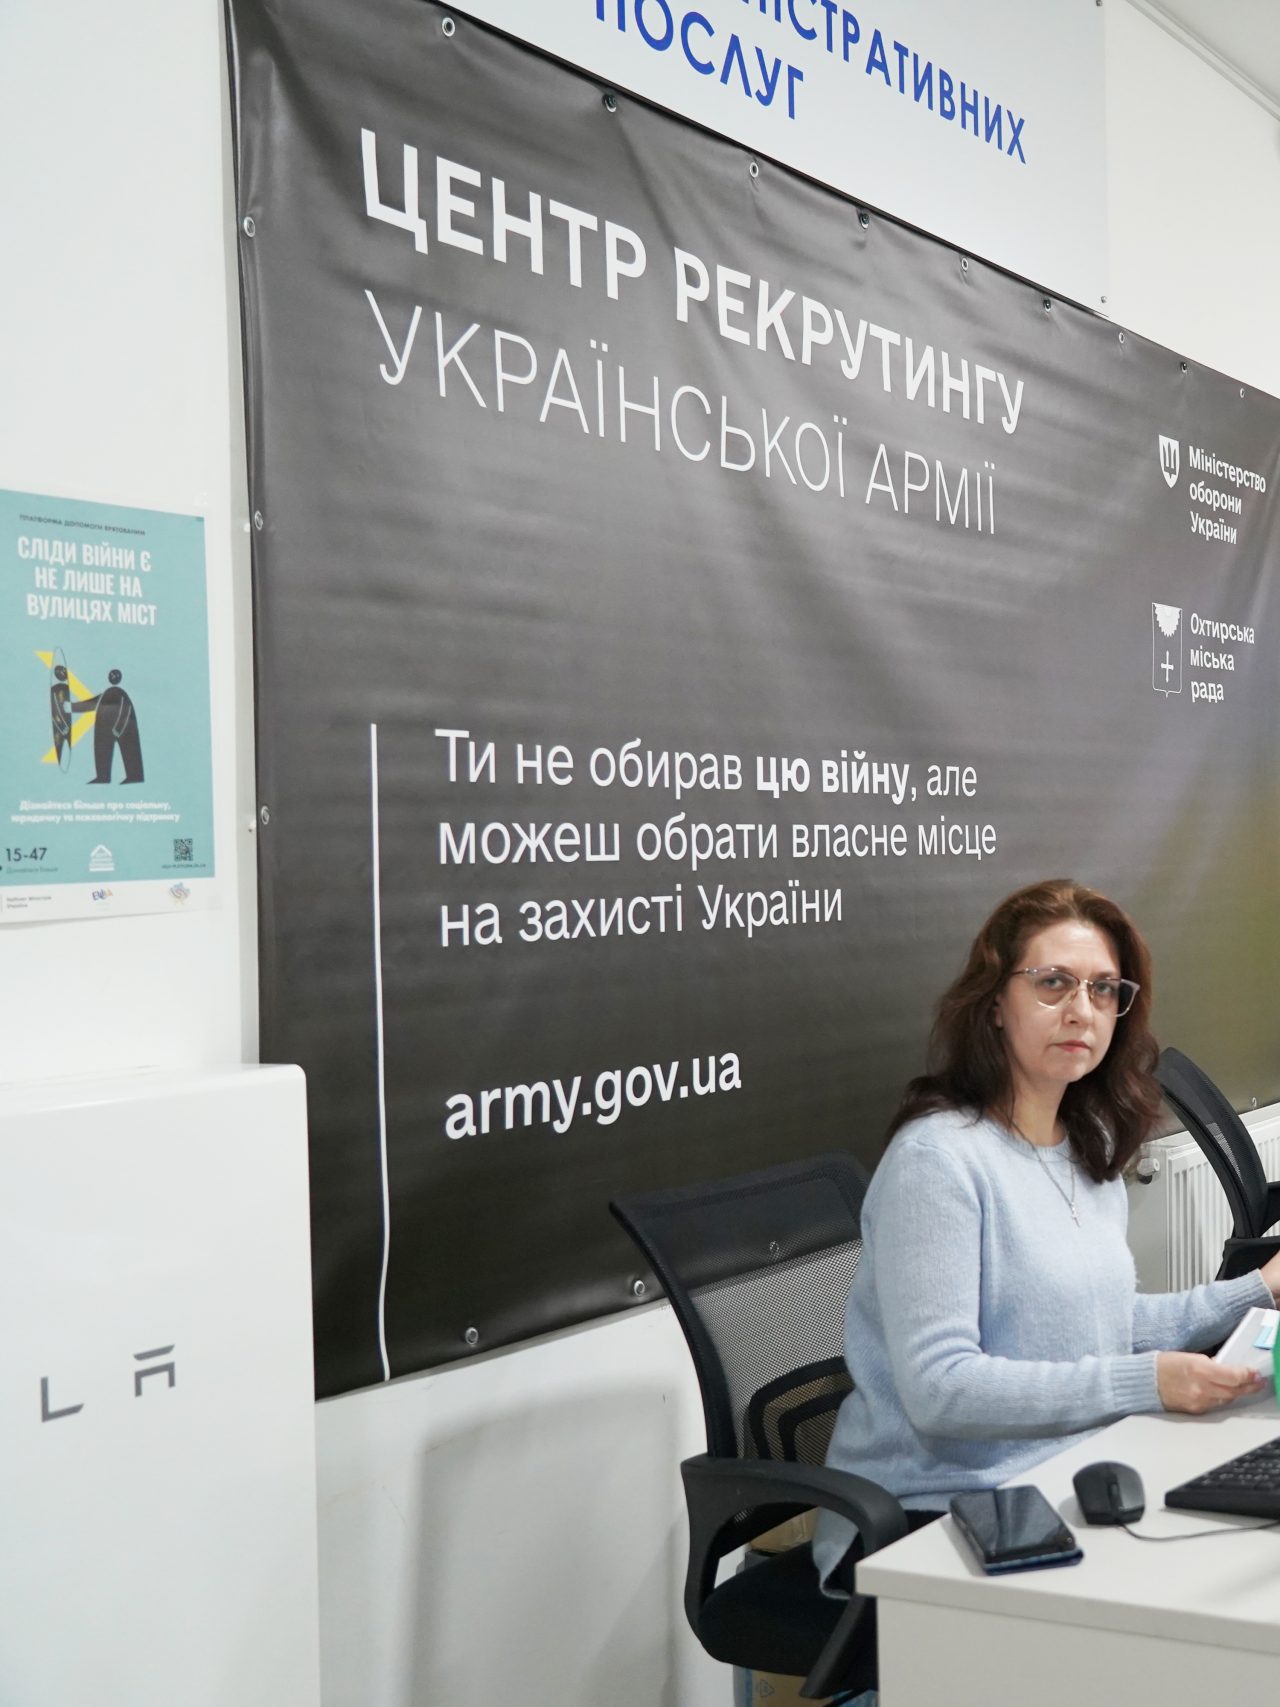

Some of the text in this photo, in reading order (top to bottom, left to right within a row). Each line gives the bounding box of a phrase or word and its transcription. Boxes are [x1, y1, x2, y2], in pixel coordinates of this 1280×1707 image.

[740, 0, 1027, 165] СТРАТИВНИХ
[360, 127, 1025, 435] ЦЕНТР РЕКРУТИНГУ
[364, 289, 997, 535] УКРАЇНСЬКОЇ АРМІЇ
[1188, 445, 1267, 493] Міністерство
[1189, 480, 1242, 515] оборони
[1189, 510, 1238, 545] України
[17, 536, 152, 573] СЛІДИ ВІЙНИ Є
[34, 565, 143, 598] НЕ ЛИШЕ НА
[26, 593, 158, 627] ВУЛИЦЯХ МІСТ
[1190, 612, 1255, 645] Охтирська
[1190, 645, 1235, 671] міська
[1190, 680, 1225, 703] рада
[434, 728, 978, 805] Ти не обирав цю війну, але
[6, 847, 47, 861] 15-47
[438, 812, 998, 872] можеш обрати власне місце
[440, 880, 844, 947] на захисті України
[444, 1051, 742, 1140] army.gov.ua
